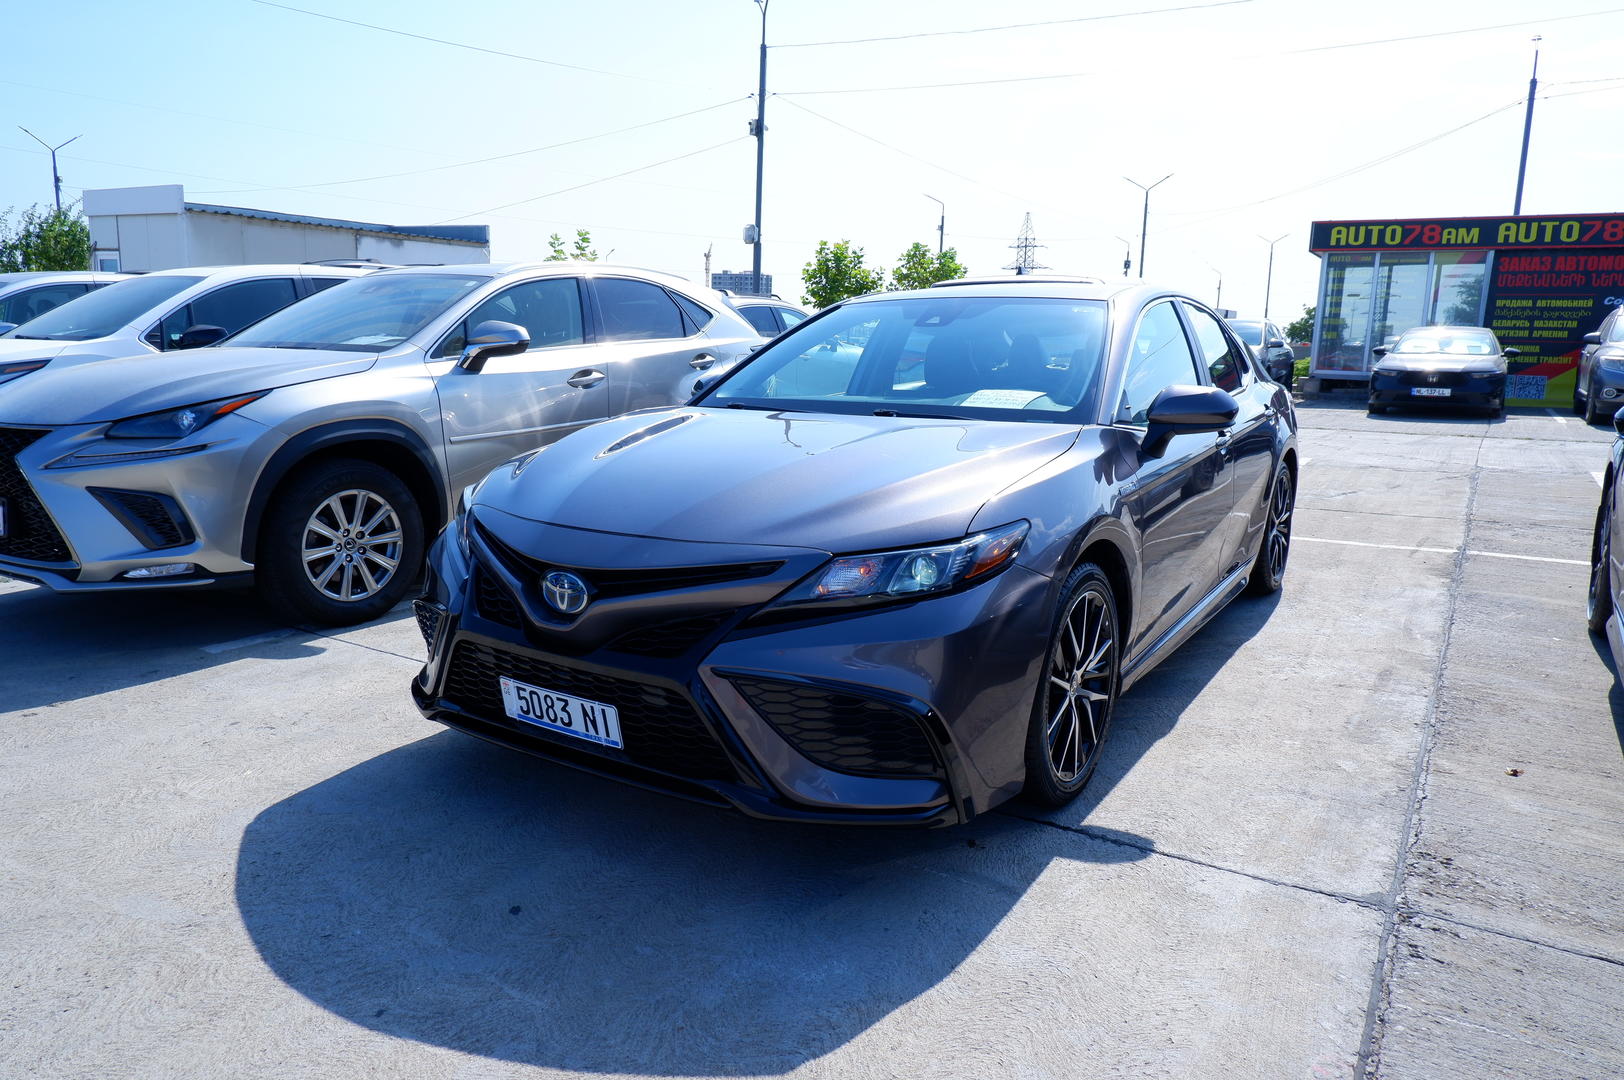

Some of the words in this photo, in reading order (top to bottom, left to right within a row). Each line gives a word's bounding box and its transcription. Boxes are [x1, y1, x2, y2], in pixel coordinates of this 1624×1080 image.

[1330, 224, 1480, 246] AUTO78AM
[1497, 220, 1624, 244] AUTO78
[1498, 256, 1553, 272] ЗАКАЗ
[1496, 299, 1533, 307] ПРОДАЖА
[1536, 298, 1594, 307] АВТОМОБИЛЕЙ
[1492, 319, 1530, 327] БЕЛАРУСЬ
[1533, 320, 1578, 328] КАЗАХСТАН
[1532, 330, 1569, 338] АРМЕНИЯ
[515, 685, 573, 728] 5083
[580, 702, 611, 738] NI
